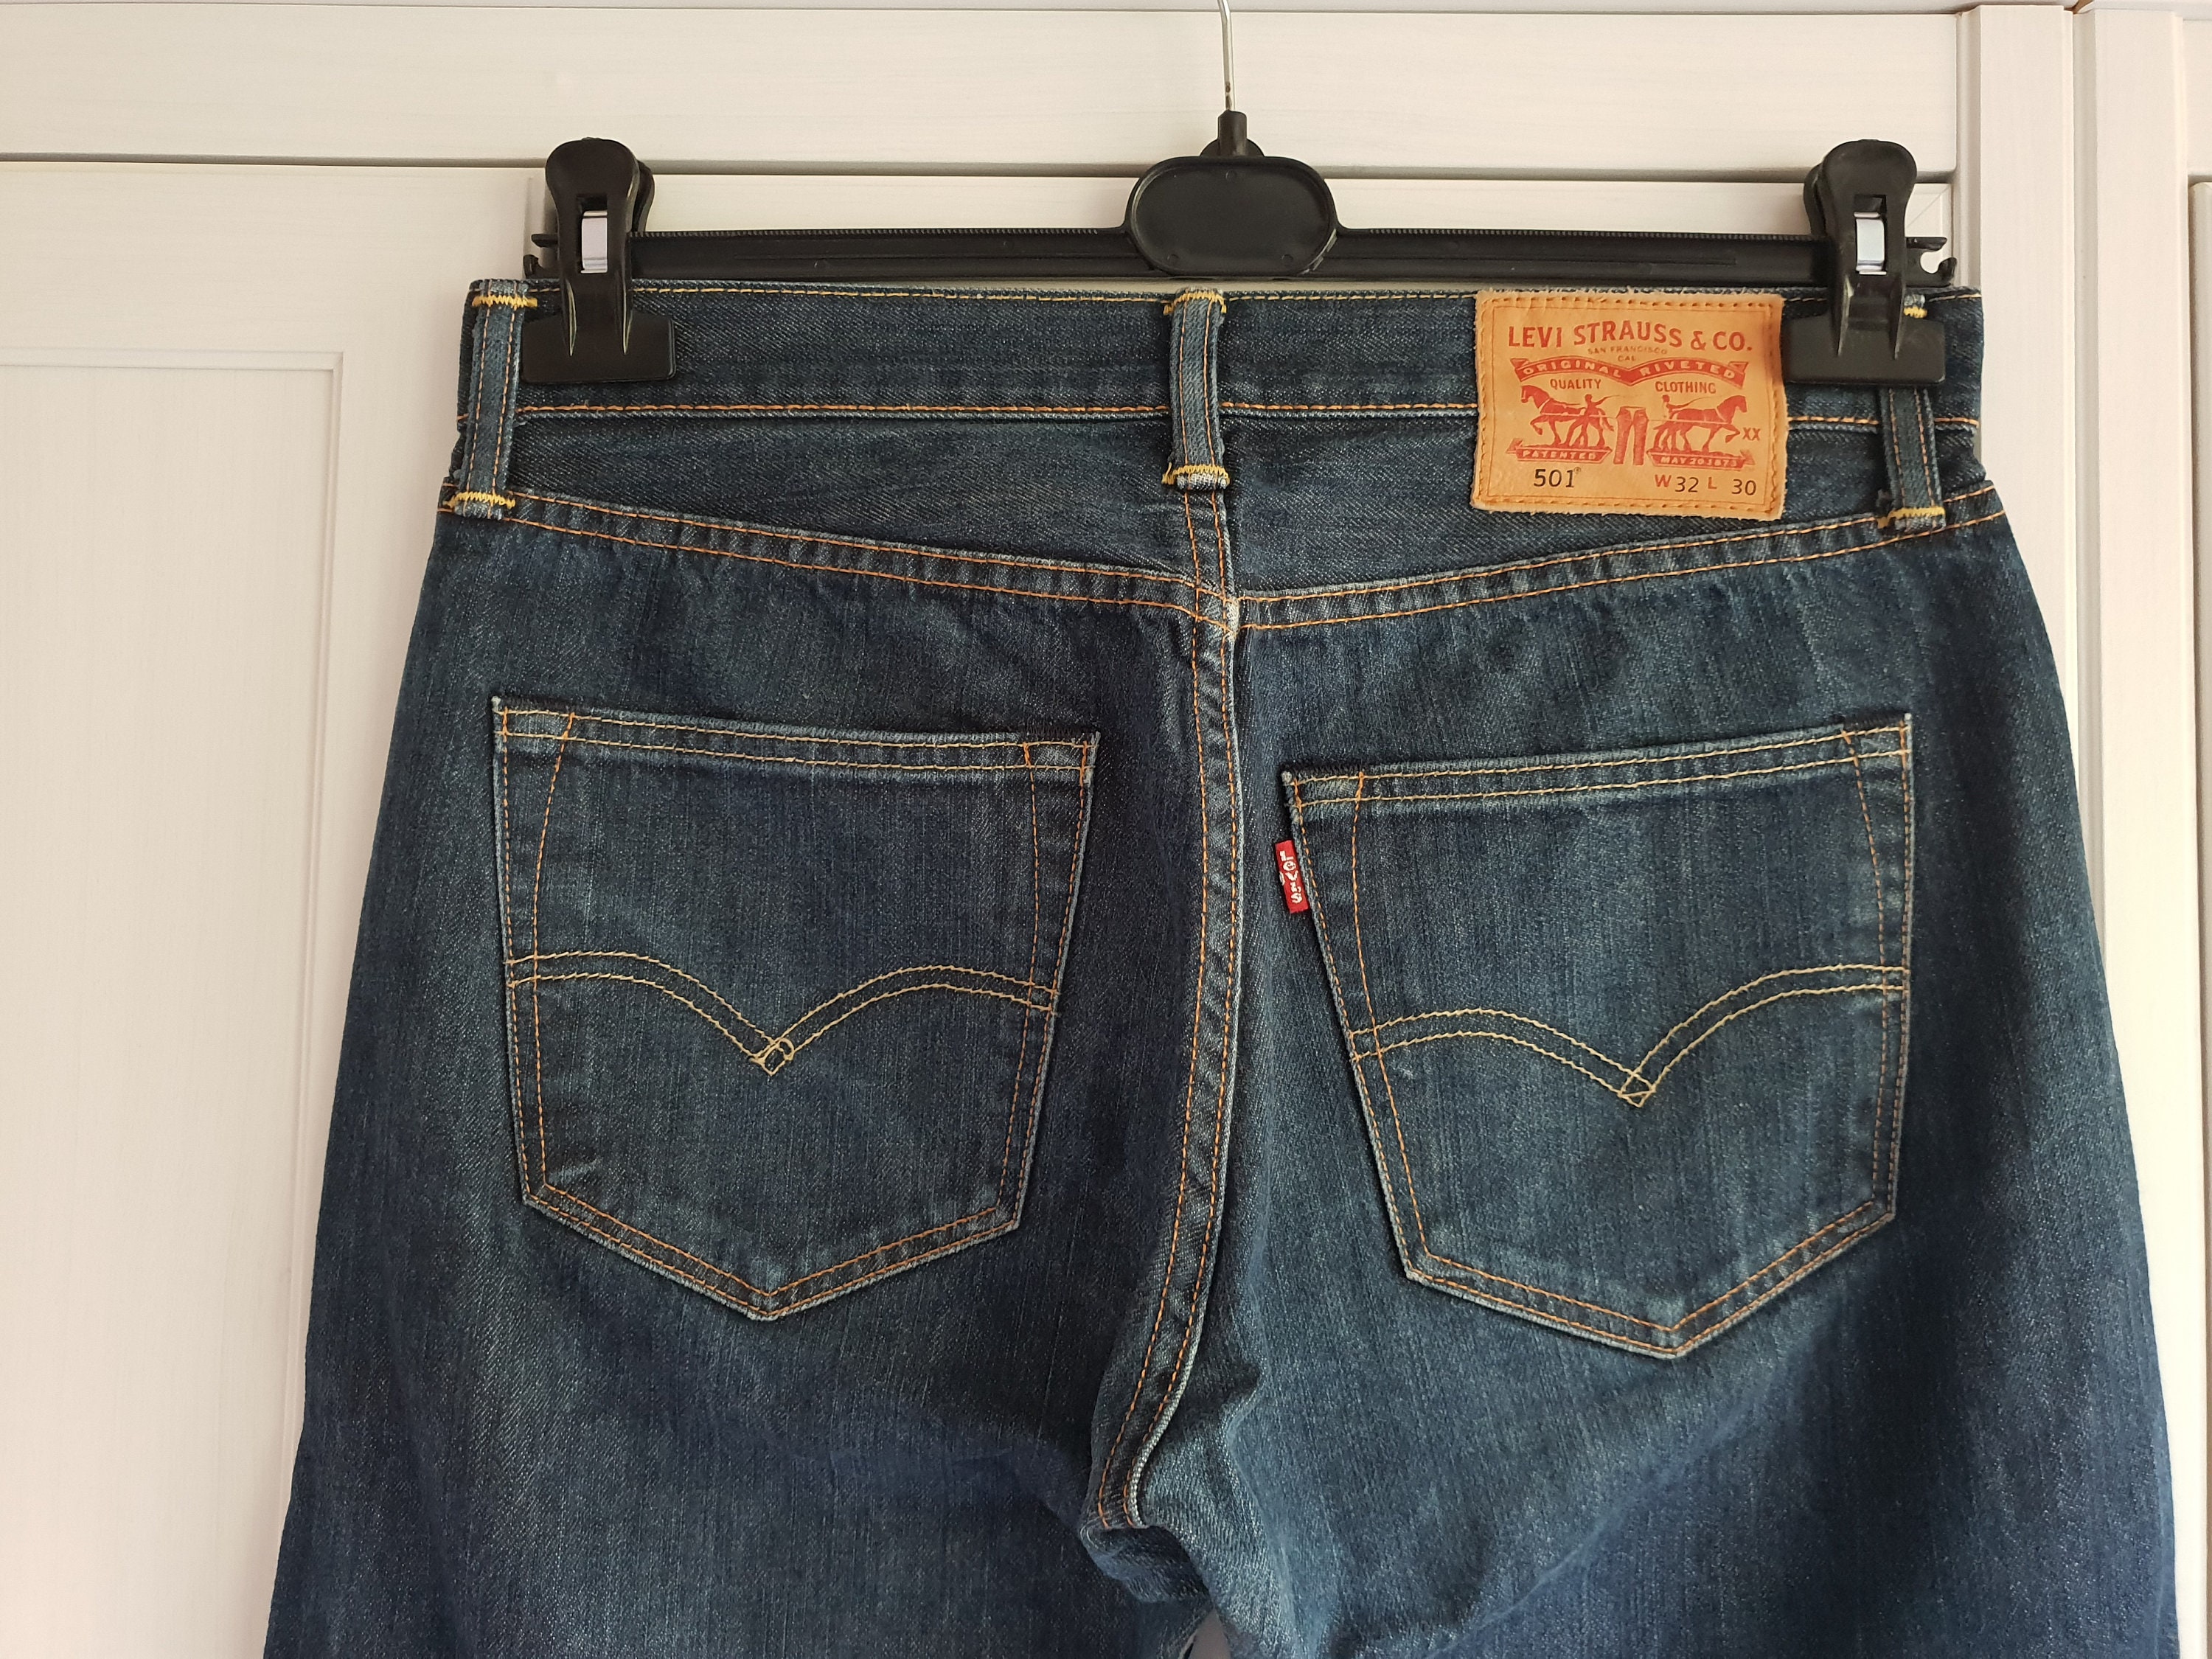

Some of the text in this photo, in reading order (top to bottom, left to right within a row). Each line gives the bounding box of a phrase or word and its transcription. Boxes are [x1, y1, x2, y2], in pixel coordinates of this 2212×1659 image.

[1509, 320, 1753, 351] LEVI STRAUSS & CO.
[1610, 345, 1668, 355] FRANCISCO
[1523, 360, 1736, 379] ORIGINAL RIVETED
[1550, 378, 1717, 394] QUALITY CLOTHING
[1742, 427, 1761, 441] XX
[1522, 450, 1597, 460] PATENTED
[1660, 456, 1686, 465] MAY
[1689, 457, 1705, 465] 20
[1655, 474, 1757, 495] W 32 L 30
